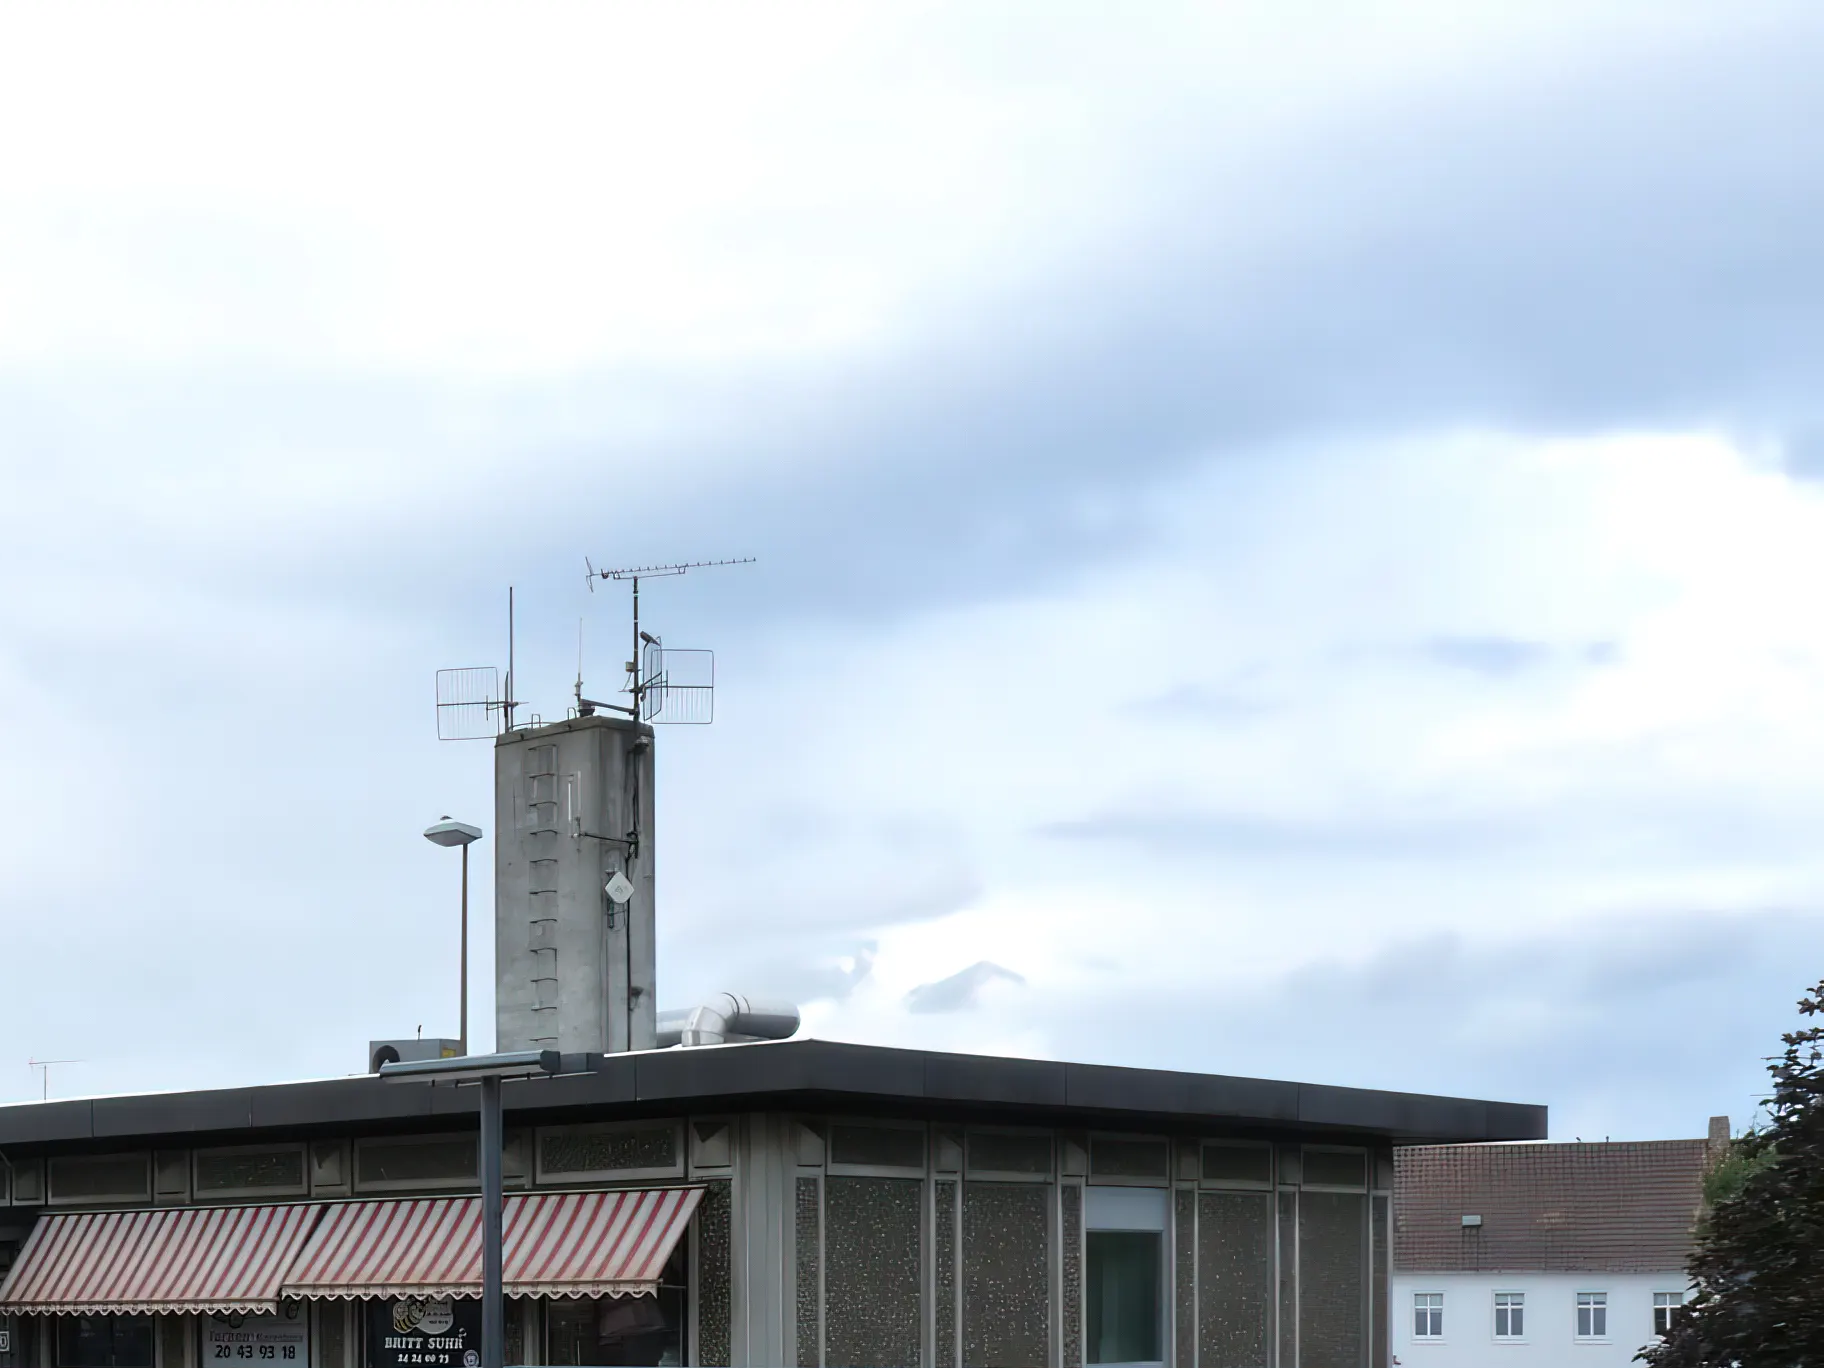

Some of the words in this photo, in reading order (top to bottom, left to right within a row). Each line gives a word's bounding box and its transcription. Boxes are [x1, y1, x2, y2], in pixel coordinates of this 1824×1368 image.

[384, 1337, 424, 1349] BRITT
[427, 1337, 463, 1349] SUHR
[214, 1344, 231, 1359] 20
[237, 1344, 253, 1359] 43
[259, 1344, 275, 1359] 93
[281, 1344, 296, 1360] 18
